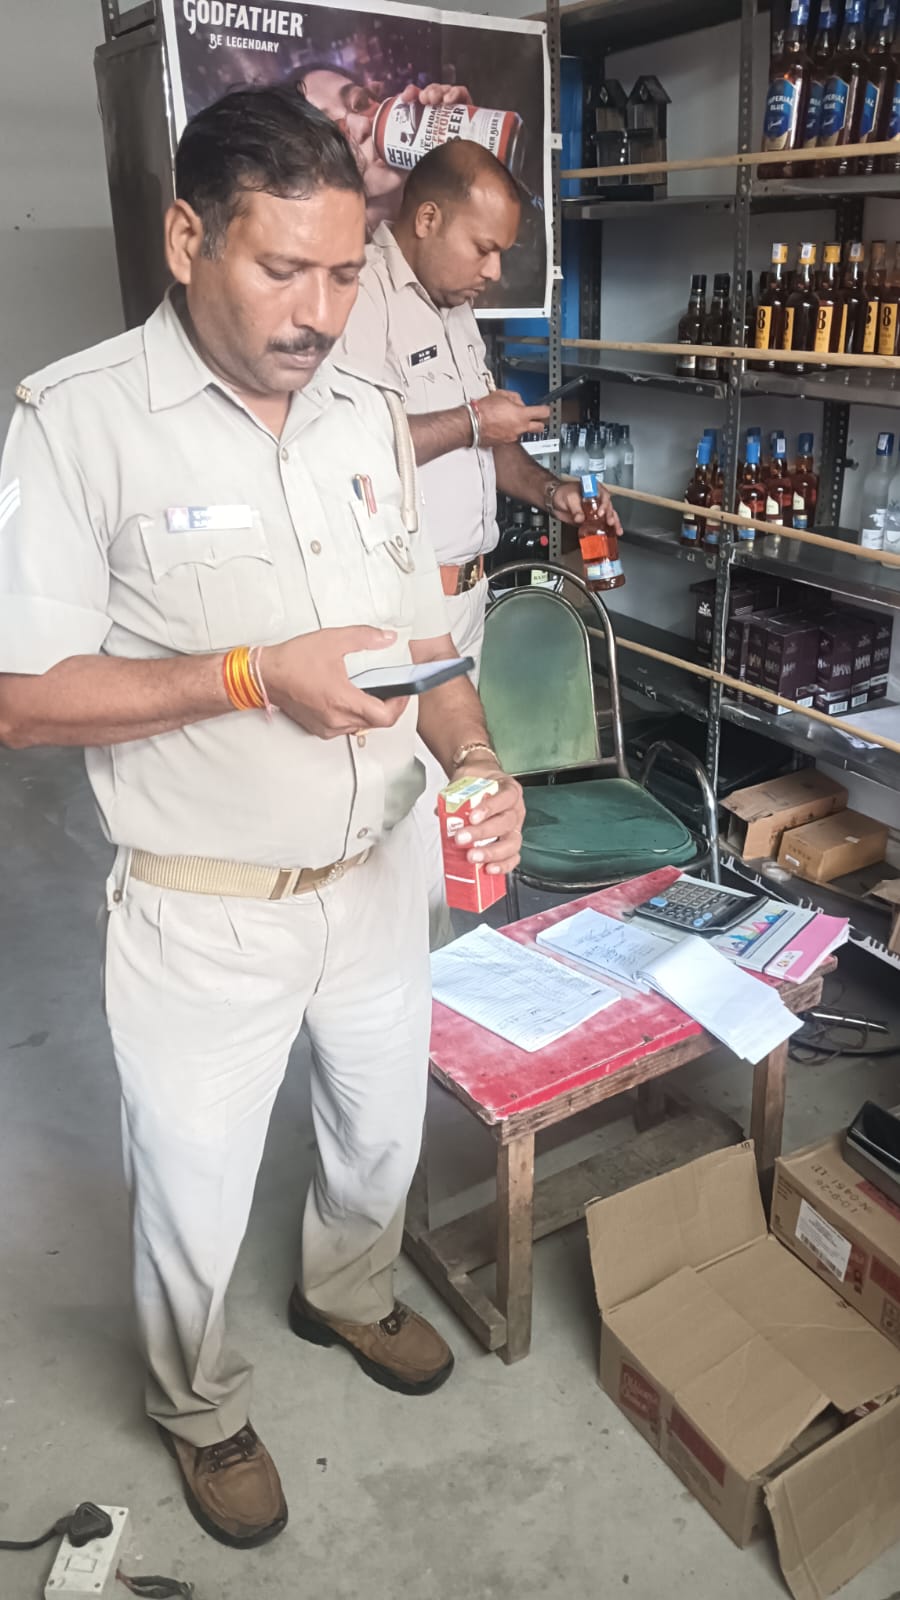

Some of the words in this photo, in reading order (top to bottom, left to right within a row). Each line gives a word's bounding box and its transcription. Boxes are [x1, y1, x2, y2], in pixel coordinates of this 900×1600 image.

[183, 0, 304, 37] GODFATHER
[208, 33, 222, 49] BE
[226, 36, 279, 53] LEGENDARY
[758, 309, 766, 329] 8
[883, 306, 892, 327] 8
